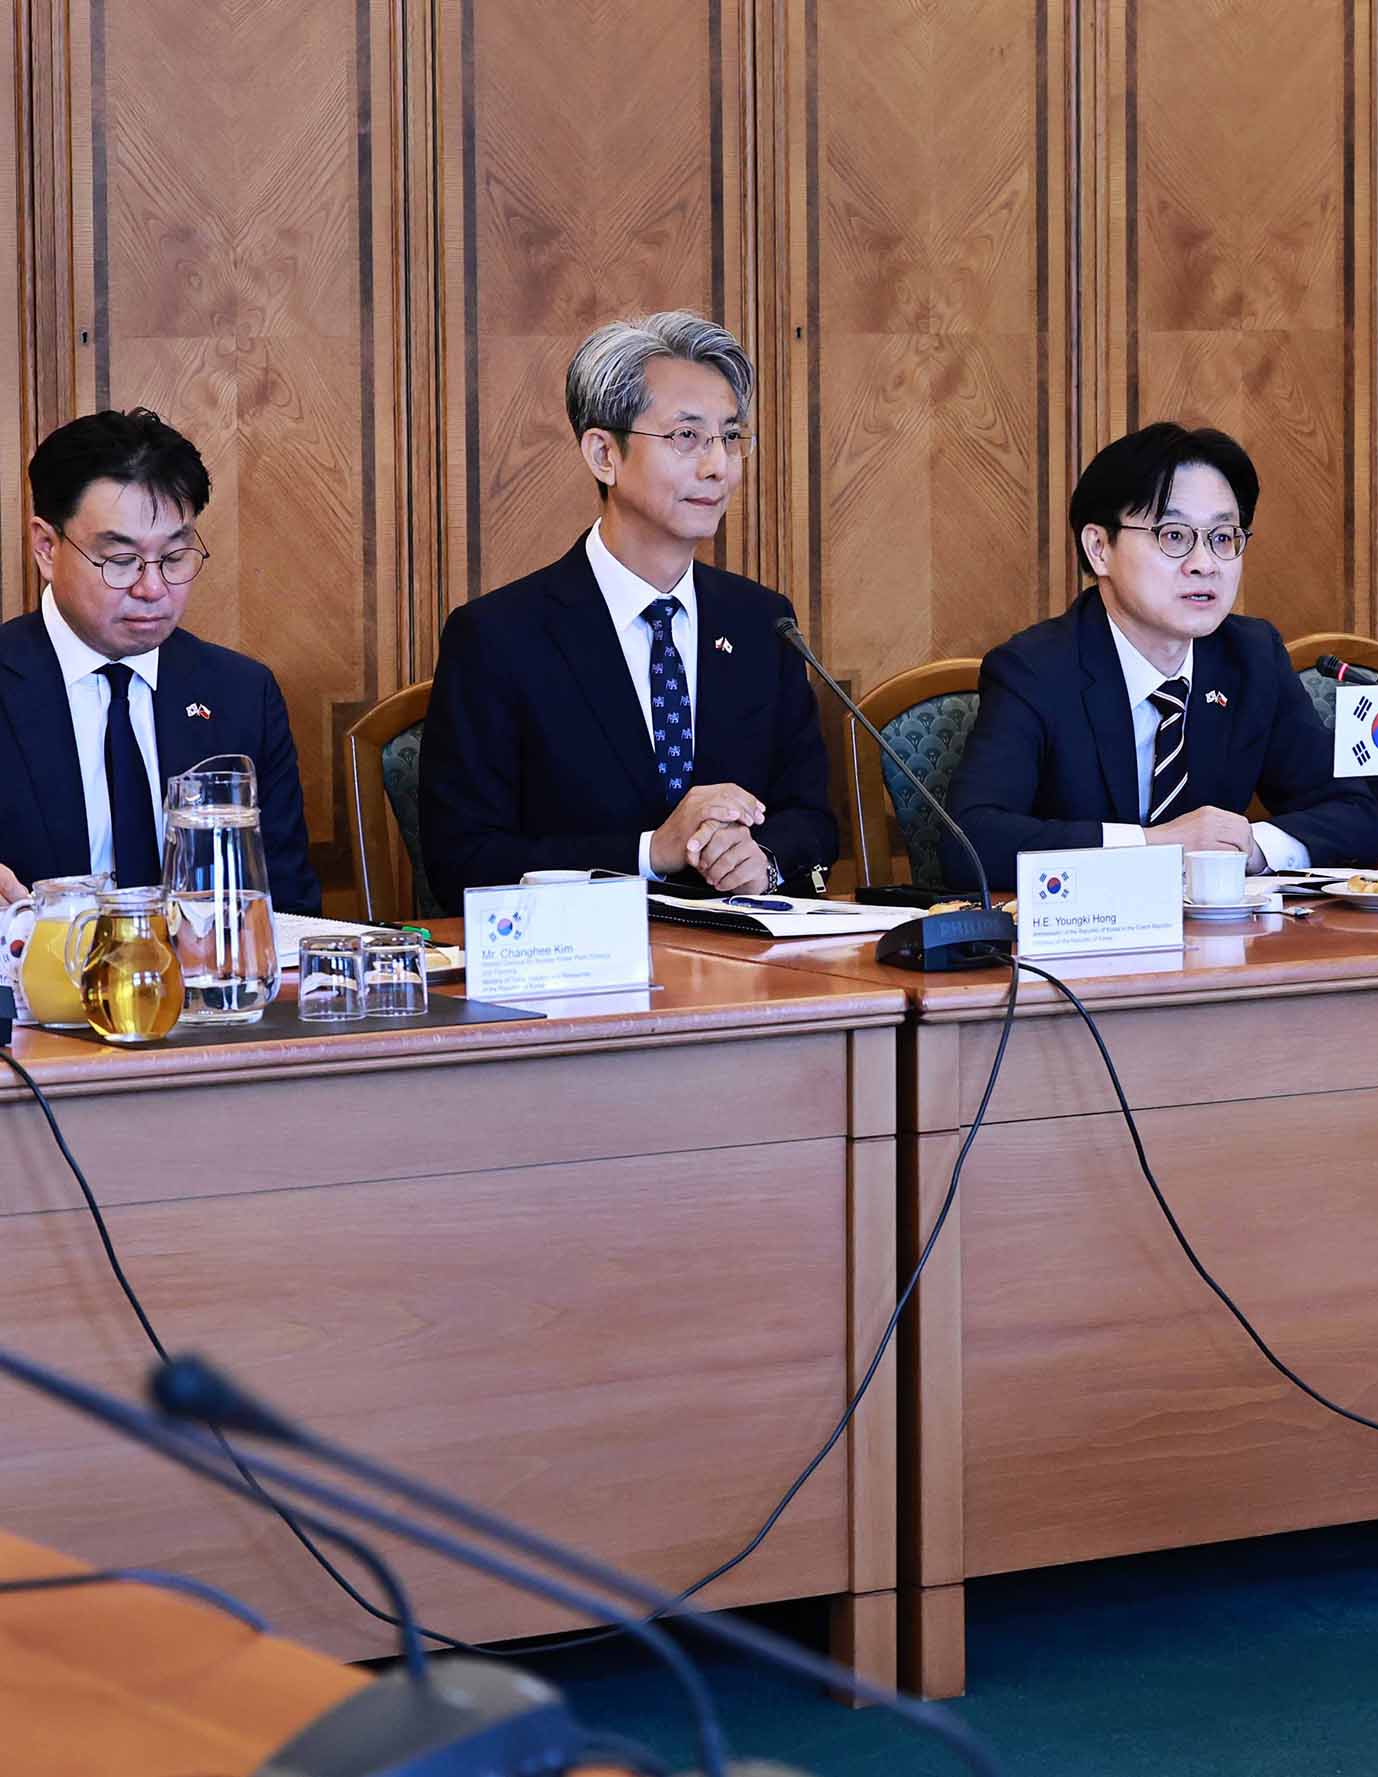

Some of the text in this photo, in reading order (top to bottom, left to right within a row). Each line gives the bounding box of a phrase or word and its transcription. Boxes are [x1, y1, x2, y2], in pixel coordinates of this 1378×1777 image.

[1032, 913, 1117, 928] H.E. Youngki Hong
[481, 948, 499, 961] Mr.
[500, 945, 552, 961] Changhee
[553, 943, 574, 955] Kim
